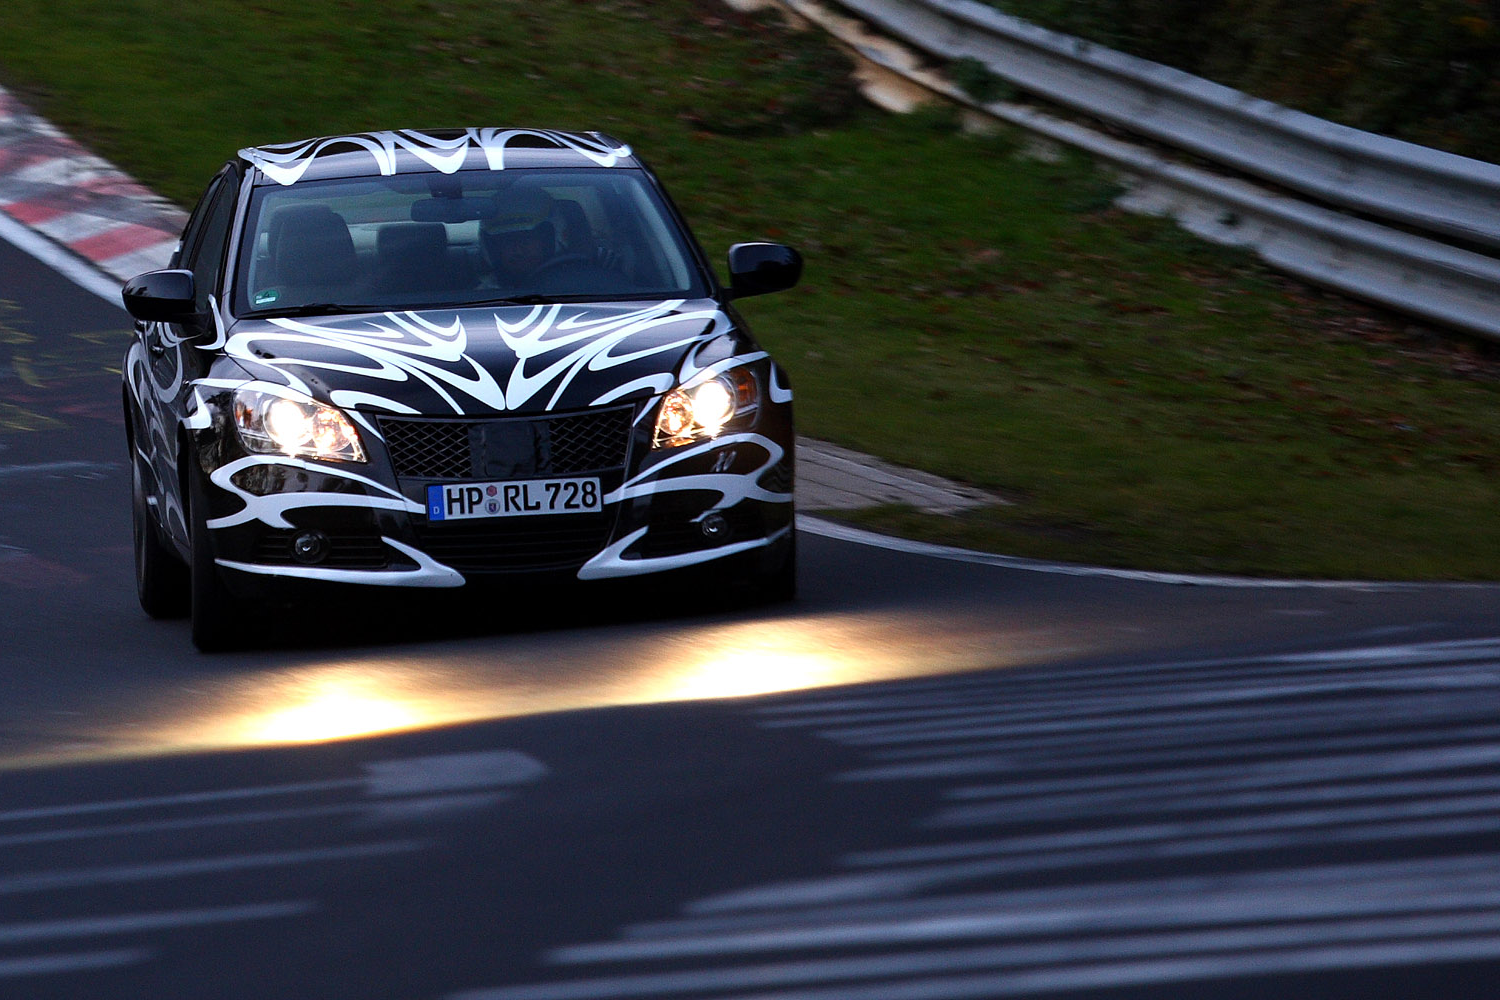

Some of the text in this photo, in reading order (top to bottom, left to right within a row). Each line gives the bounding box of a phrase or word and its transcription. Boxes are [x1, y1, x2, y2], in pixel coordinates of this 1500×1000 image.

[433, 480, 598, 516] D HP RL 728
